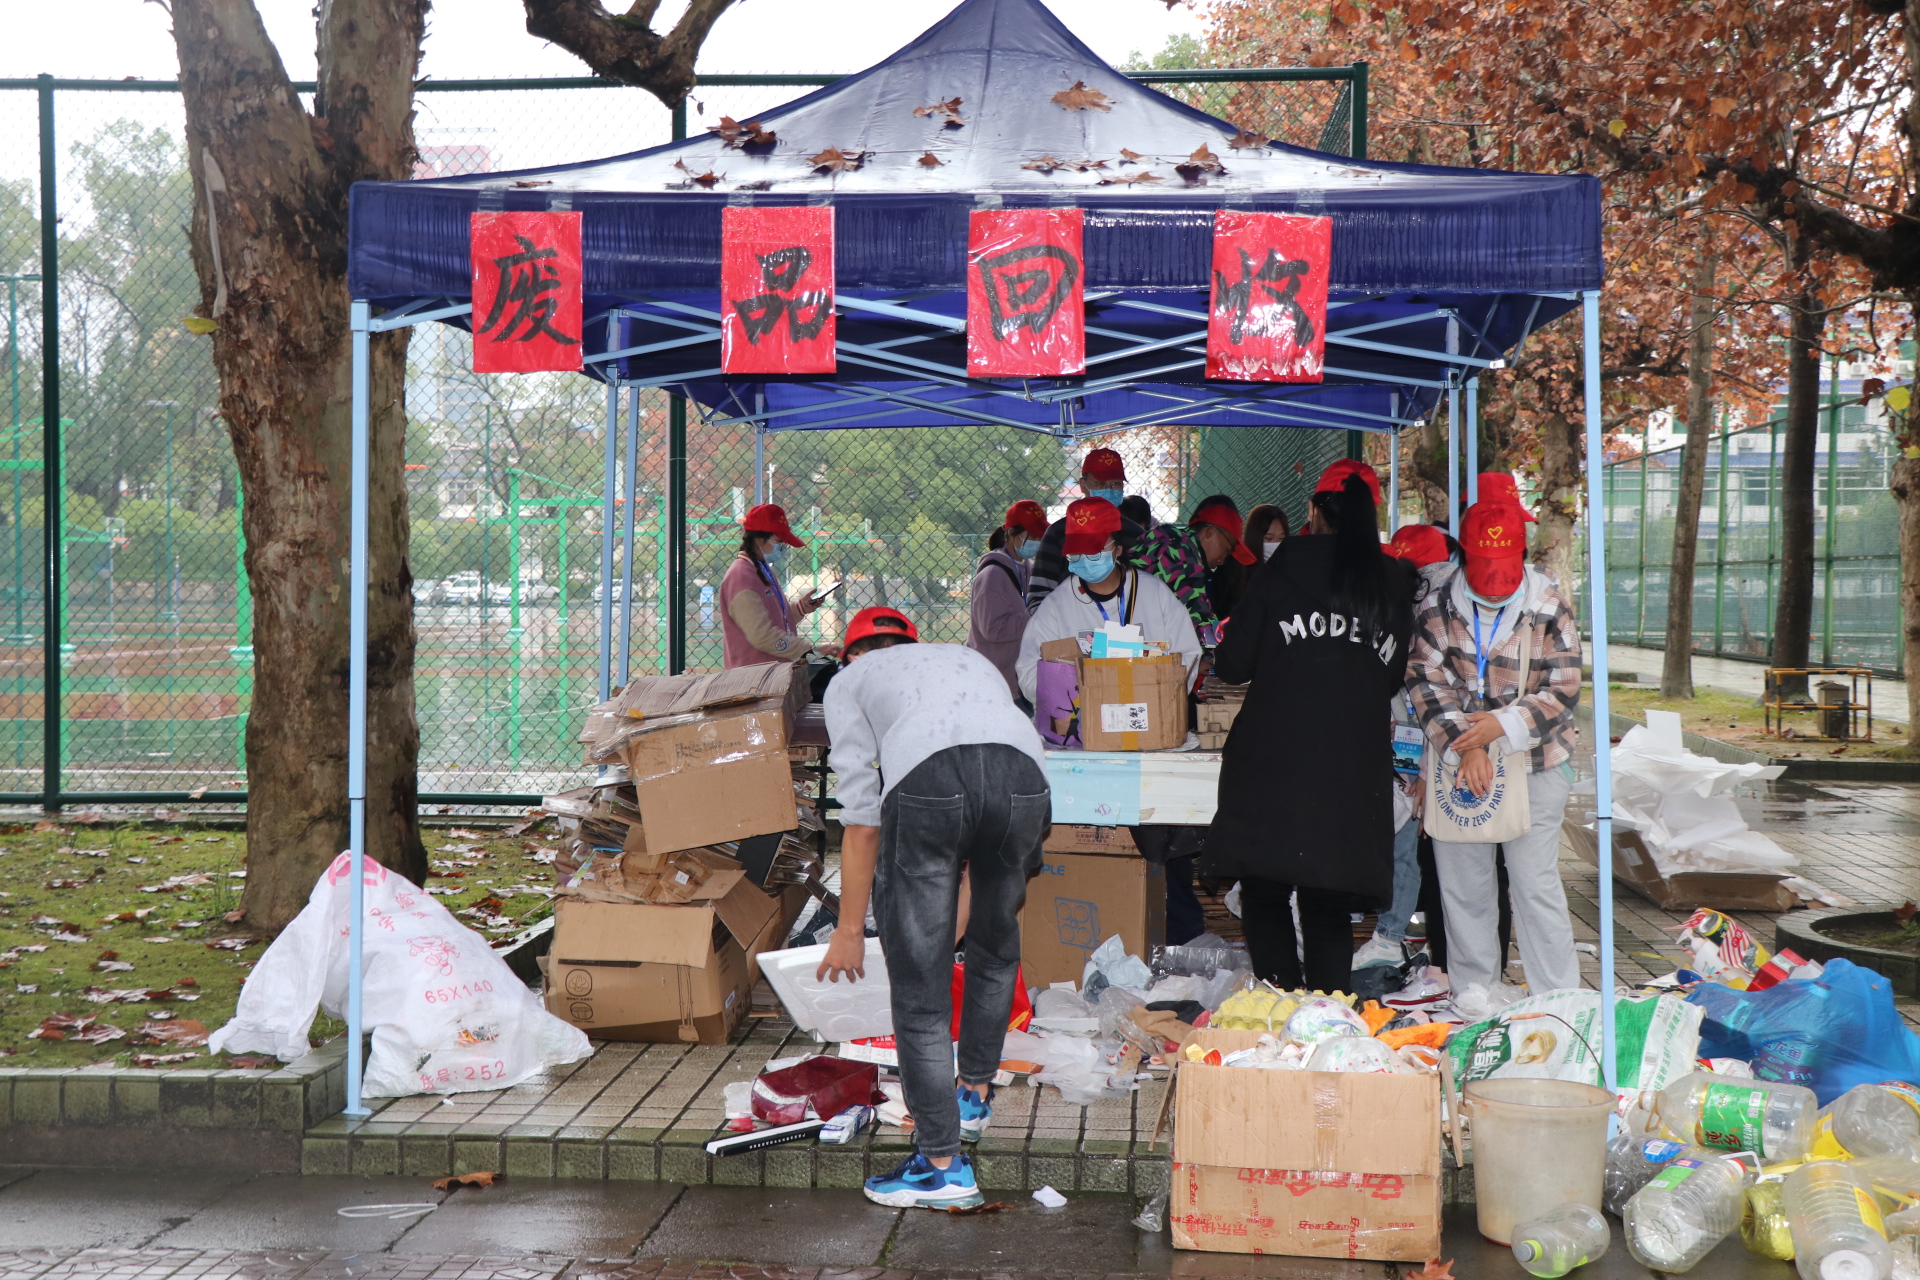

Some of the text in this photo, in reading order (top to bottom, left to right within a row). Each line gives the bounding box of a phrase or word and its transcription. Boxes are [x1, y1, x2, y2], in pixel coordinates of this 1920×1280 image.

[475, 234, 583, 346] 废
[732, 246, 833, 347] 品
[972, 244, 1080, 343] 回
[1435, 782, 1506, 828] KILOMETER ZERO PARIS
[424, 979, 494, 1005] 65X140
